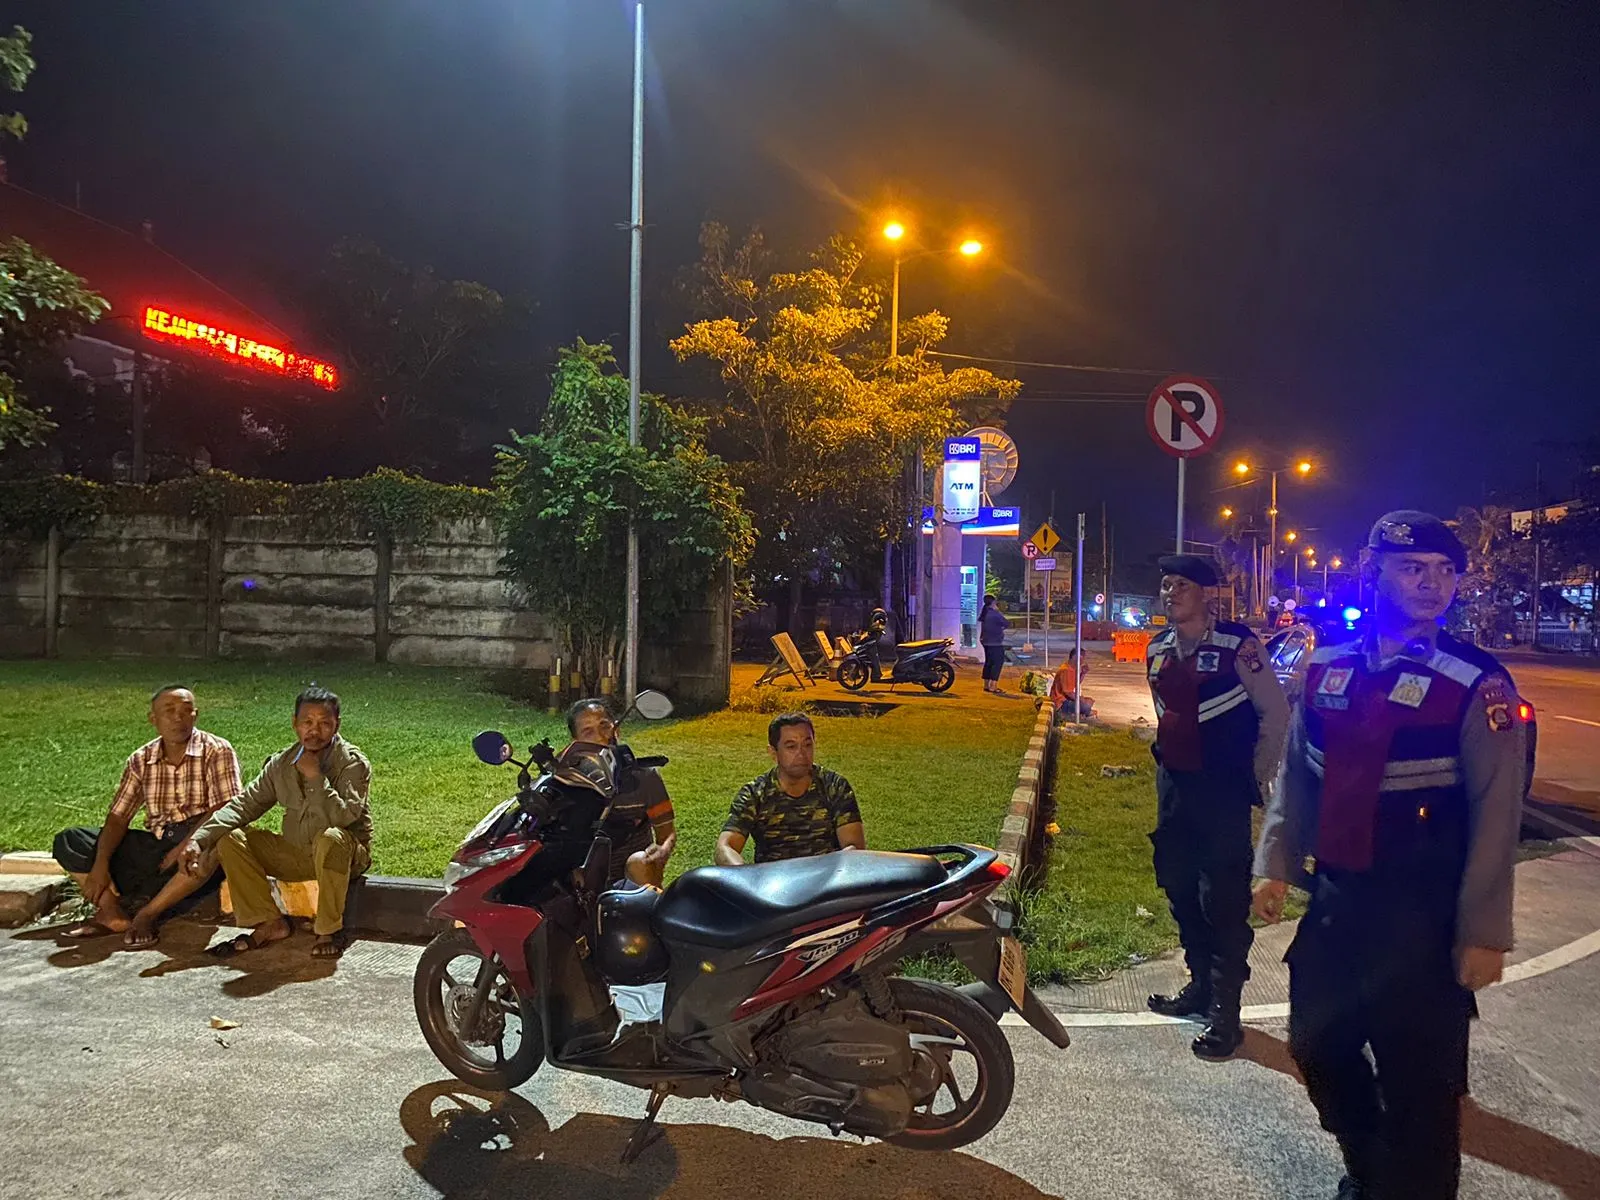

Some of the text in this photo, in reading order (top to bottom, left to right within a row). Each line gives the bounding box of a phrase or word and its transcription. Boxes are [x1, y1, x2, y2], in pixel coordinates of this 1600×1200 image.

[1171, 391, 1206, 442] P
[960, 443, 976, 454] BRI
[950, 482, 974, 490] ATM
[999, 509, 1013, 518] BRI
